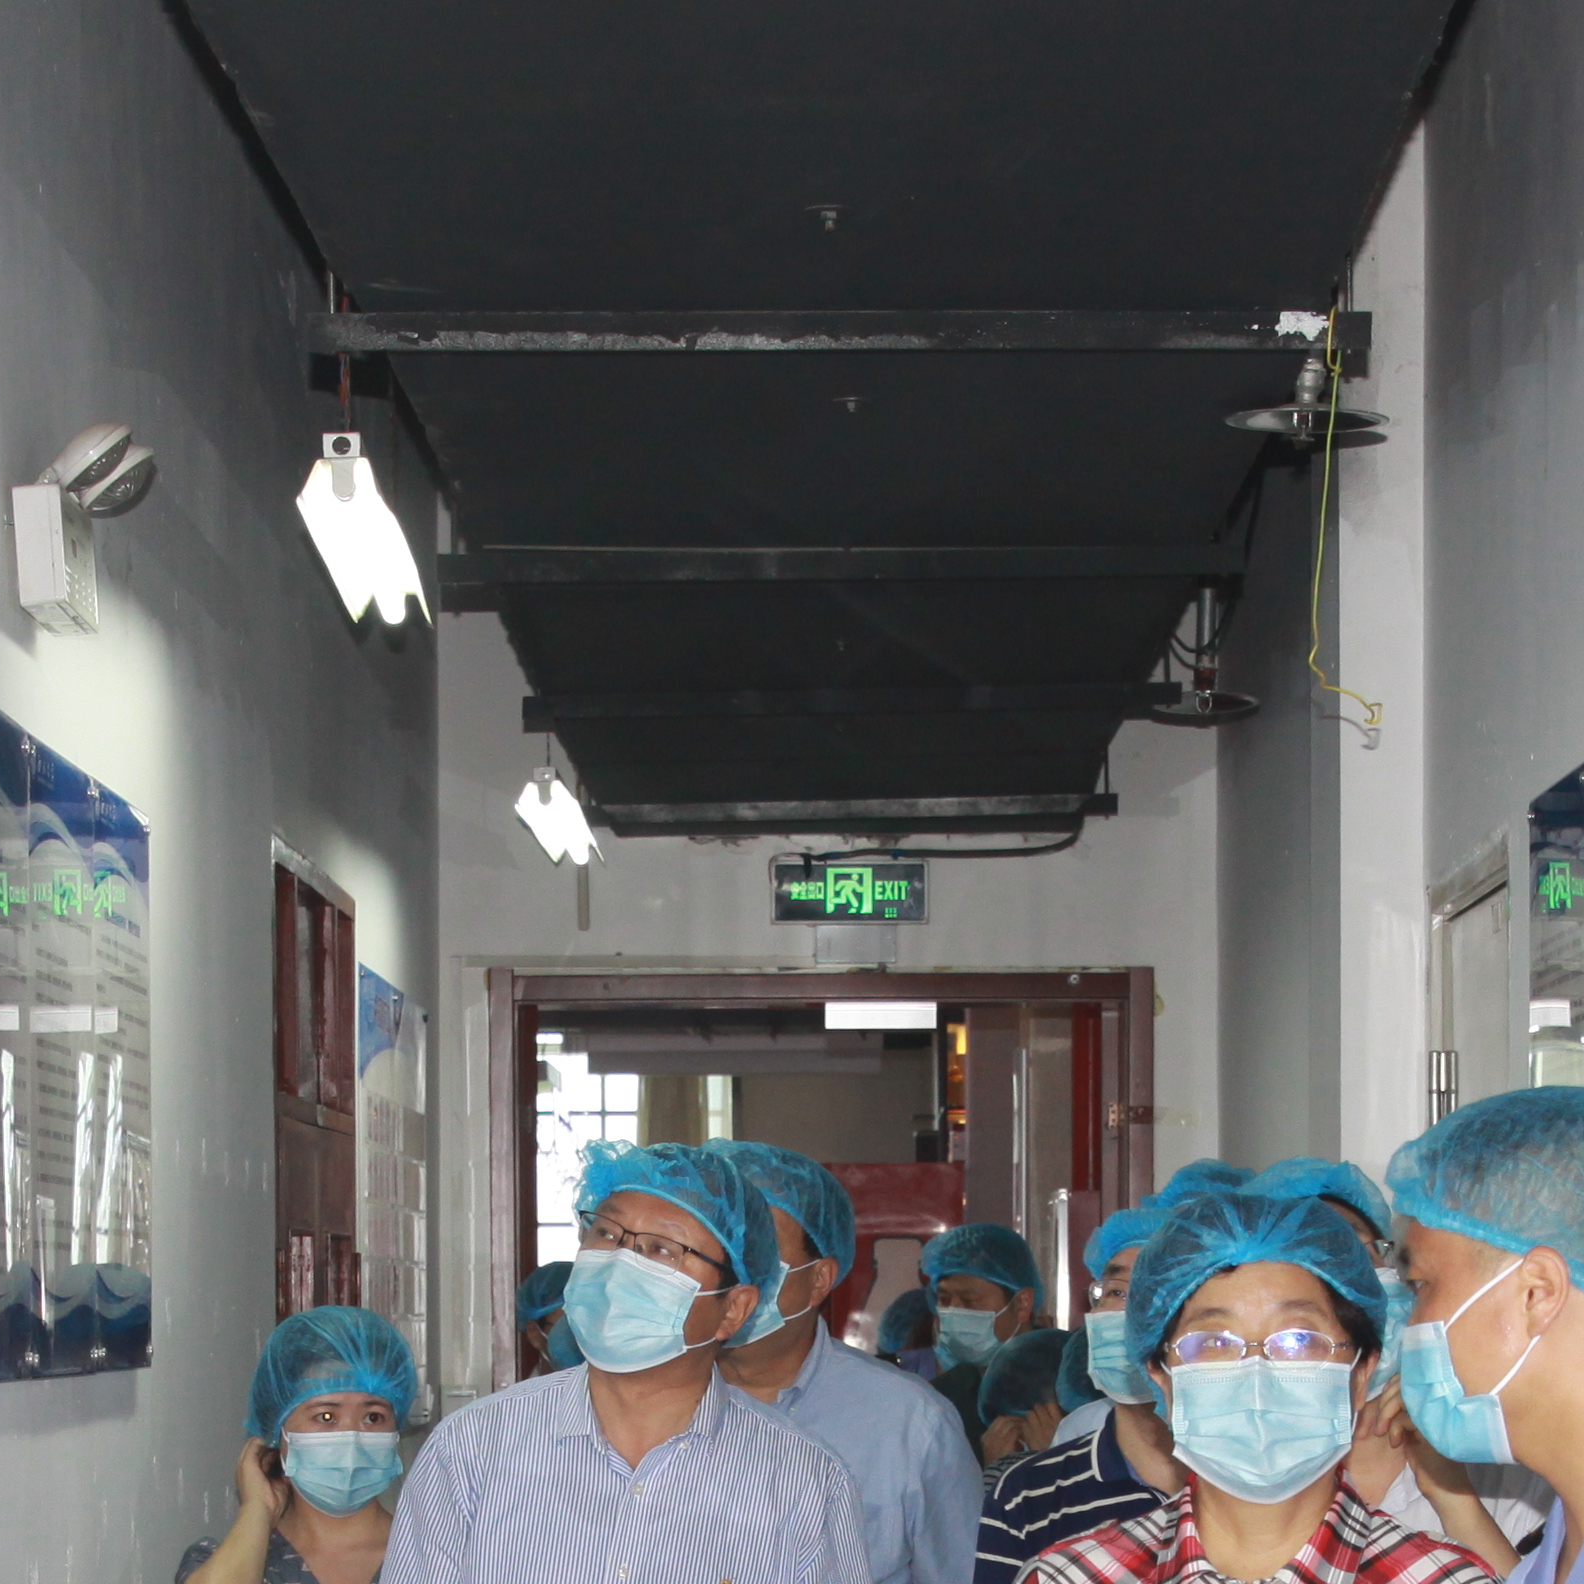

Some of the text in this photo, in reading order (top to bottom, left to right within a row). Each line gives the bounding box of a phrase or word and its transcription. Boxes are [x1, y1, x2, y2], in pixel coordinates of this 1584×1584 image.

[790, 880, 909, 900] 安全出口 EXIT
